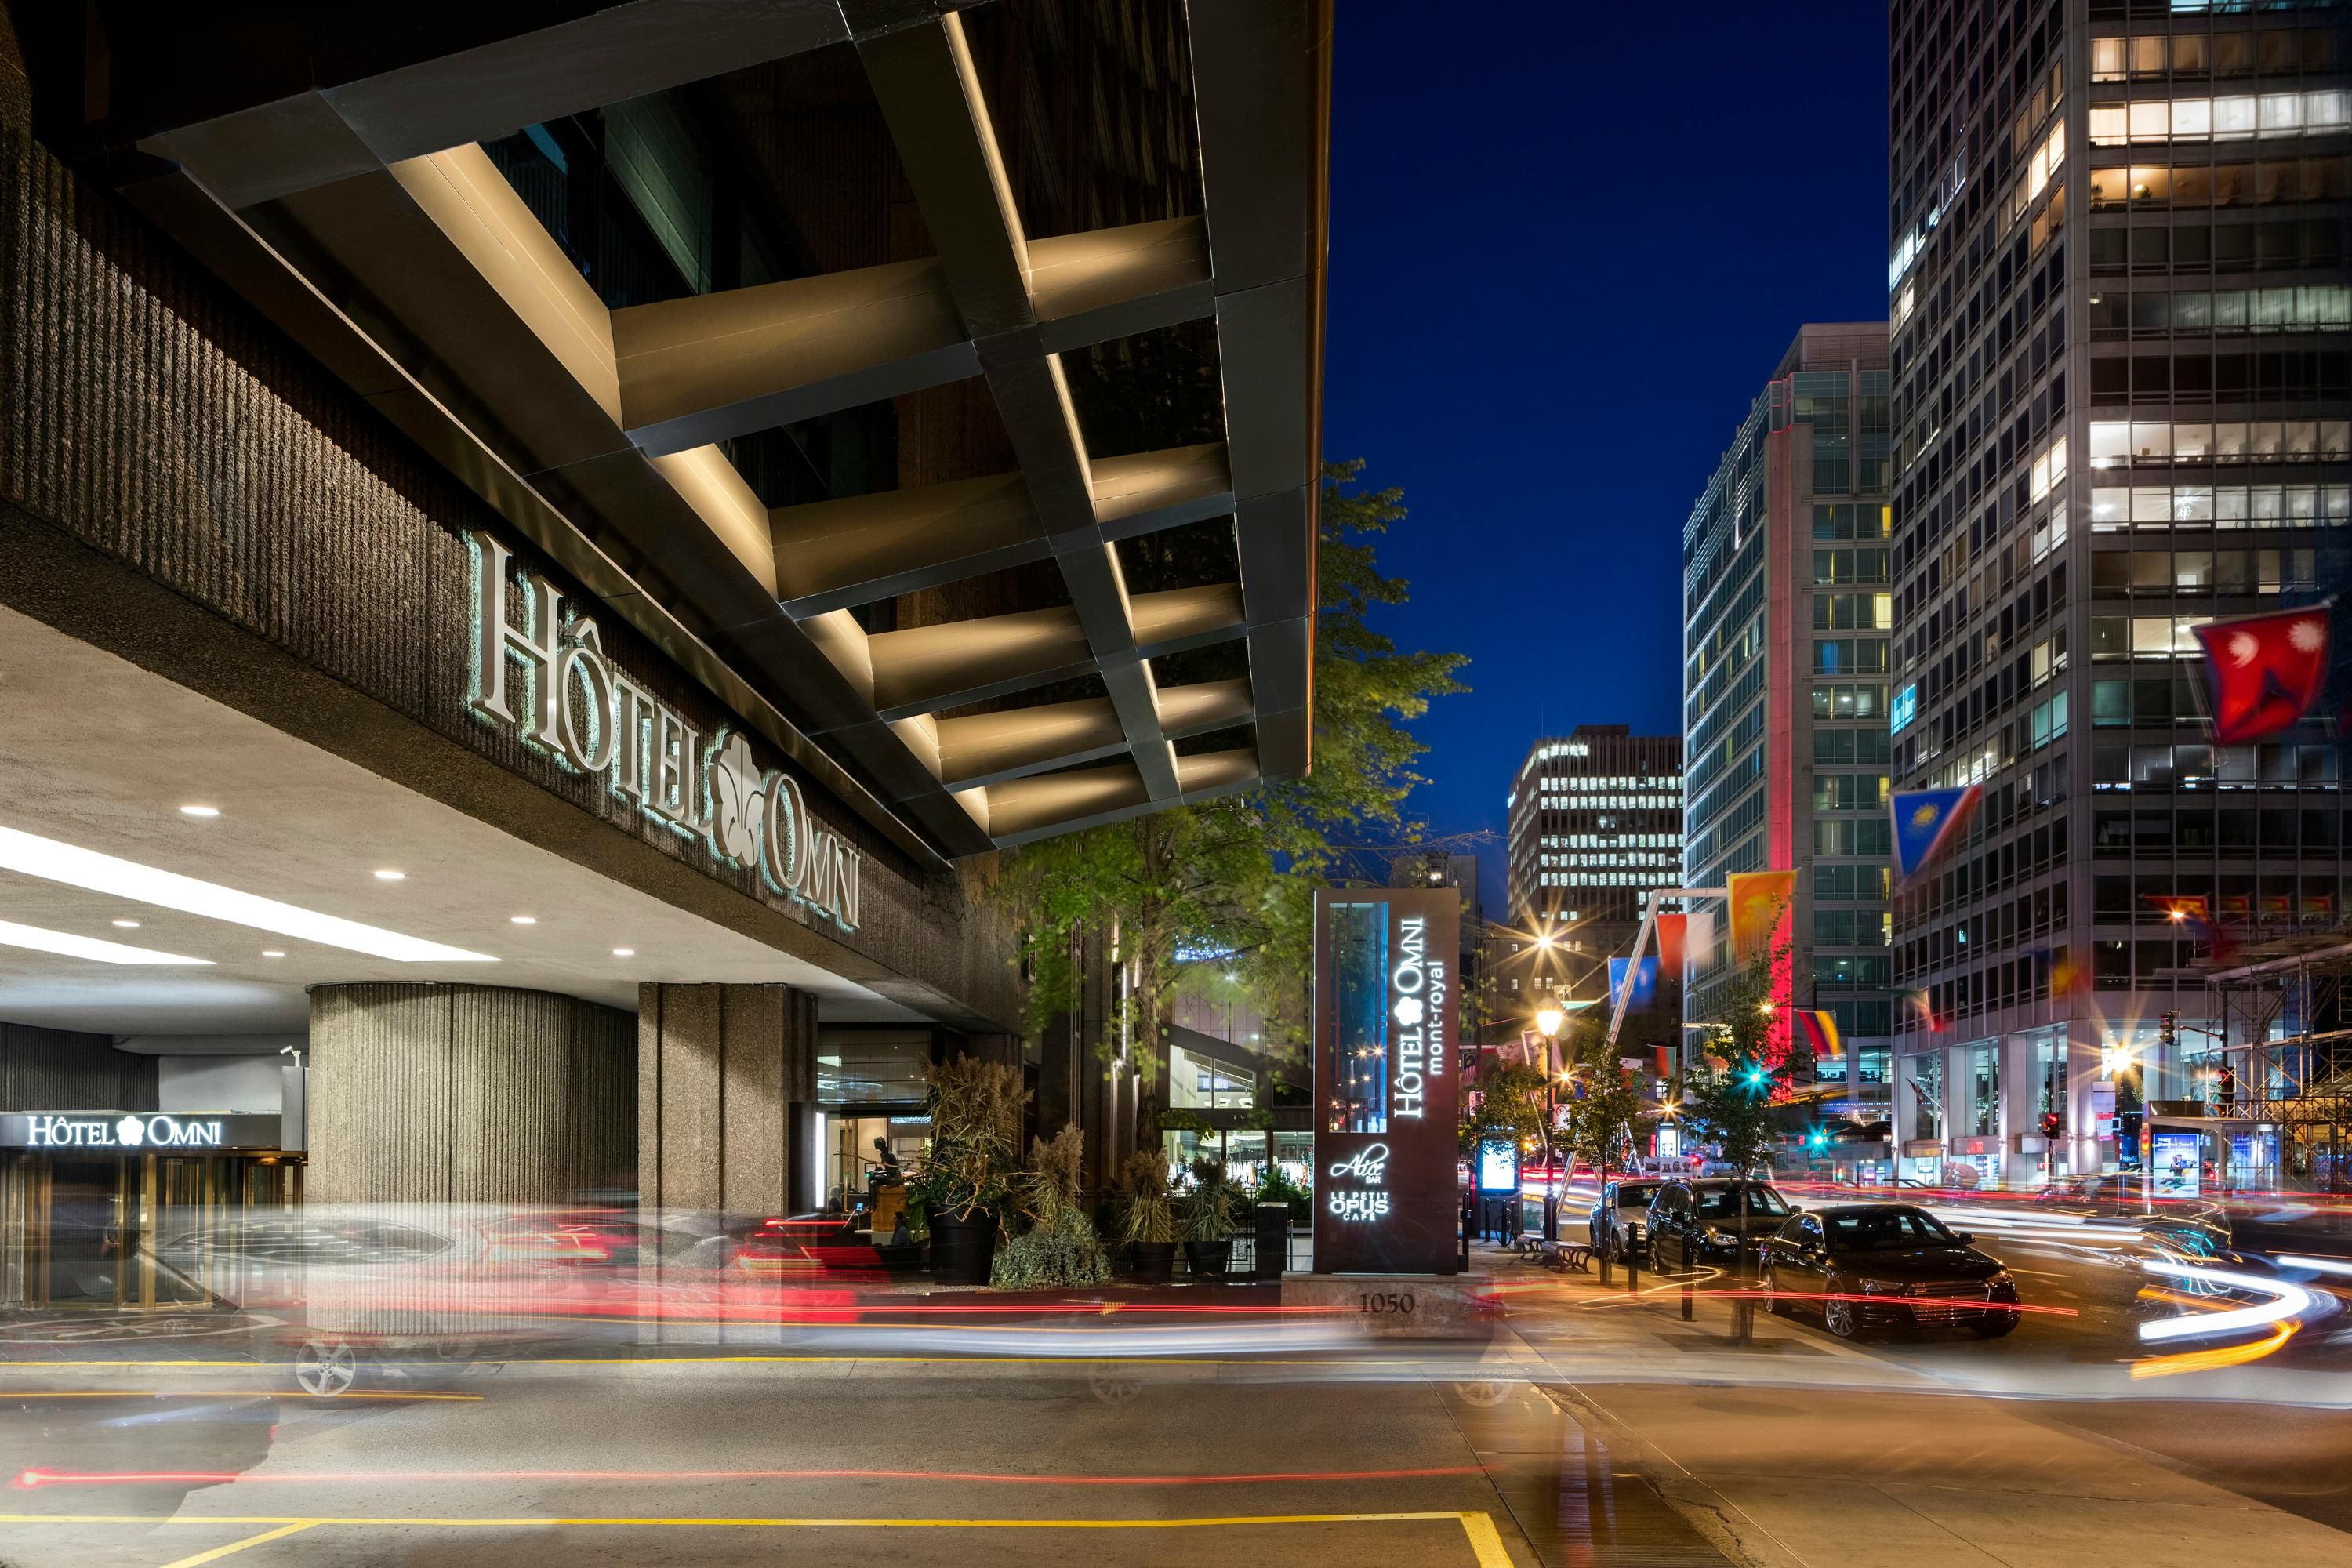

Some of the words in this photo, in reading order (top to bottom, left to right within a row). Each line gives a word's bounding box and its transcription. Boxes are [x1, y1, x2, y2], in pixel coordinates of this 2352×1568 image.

[471, 531, 710, 837] HÔTEL
[764, 772, 861, 929] OMNI
[1395, 918, 1423, 993] OMNI
[1427, 961, 1446, 1075] mont-royal
[1394, 1027, 1422, 1118] HÔTEL
[27, 1116, 115, 1145] HÔTEL
[148, 1116, 221, 1145] OMNI
[1330, 1143, 1388, 1176] Alice
[1330, 1200, 1388, 1214] OPUS
[1343, 1212, 1375, 1221] CAFÉ
[1360, 1293, 1414, 1313] 1050
